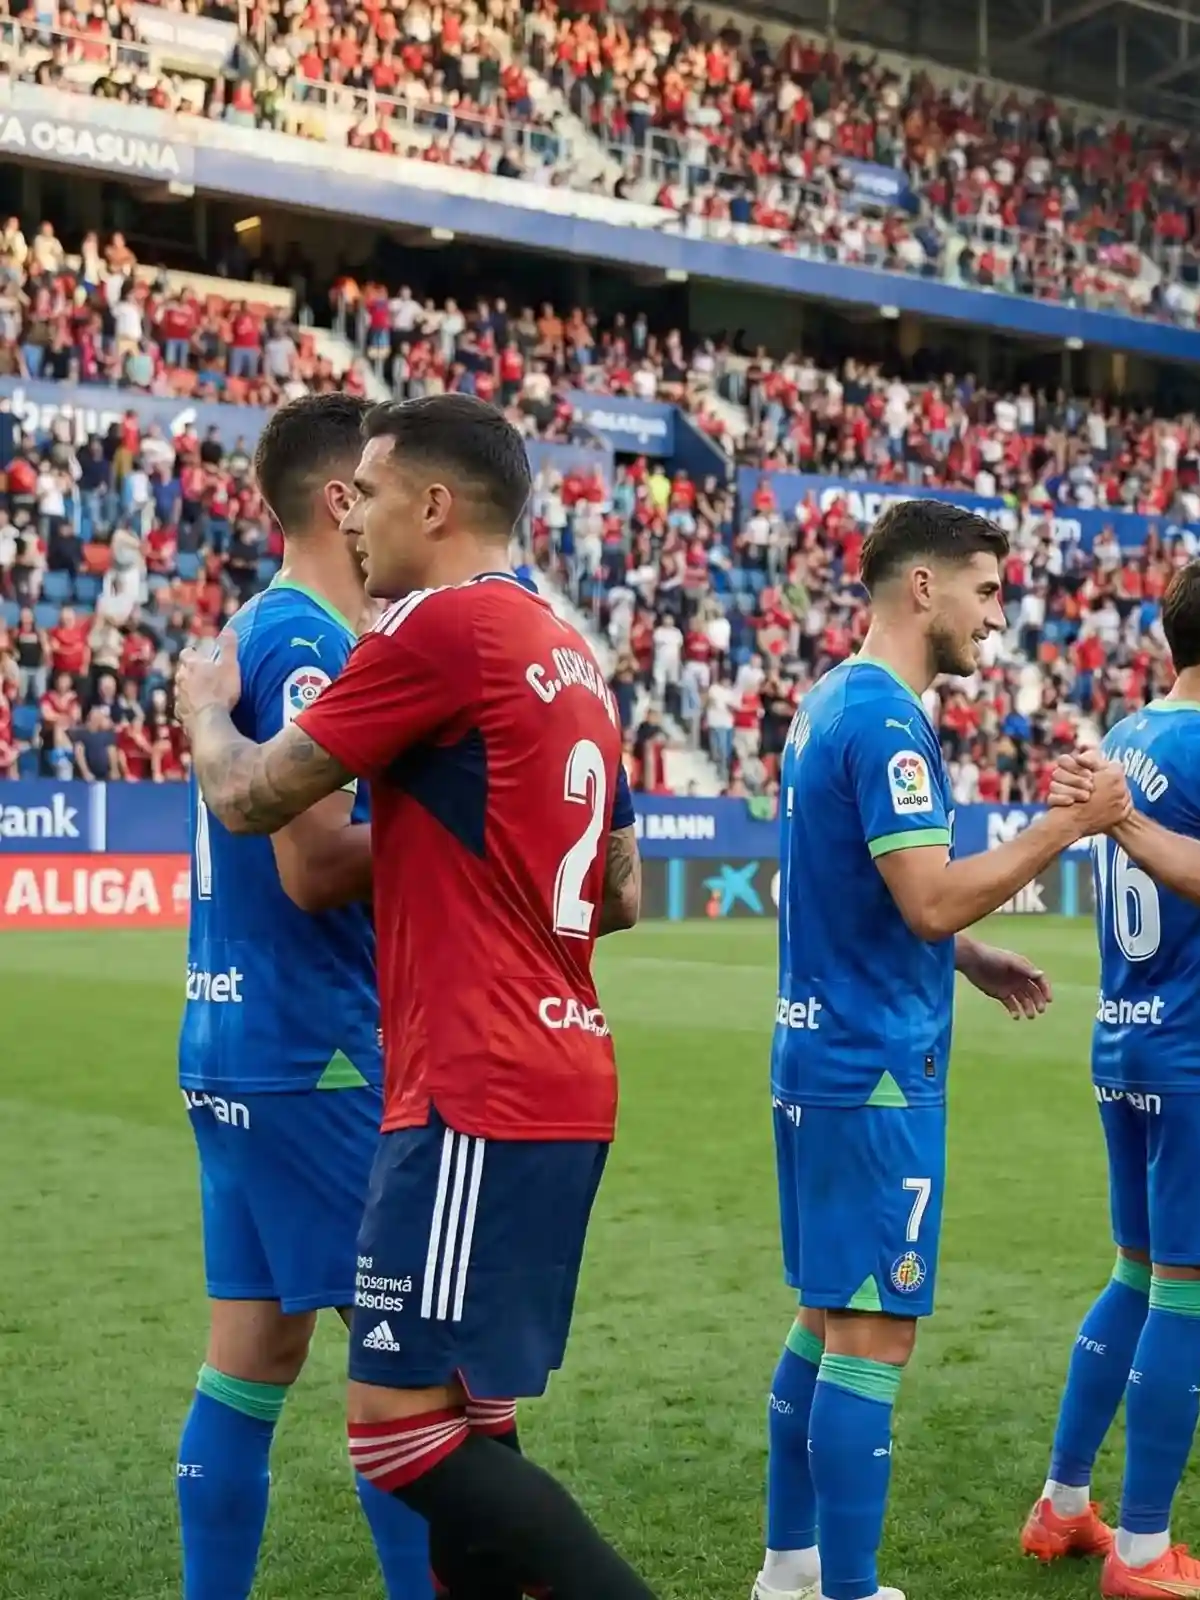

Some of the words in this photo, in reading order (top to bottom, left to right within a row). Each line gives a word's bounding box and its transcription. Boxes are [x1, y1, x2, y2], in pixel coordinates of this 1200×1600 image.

[31, 120, 180, 176] OSASUNA
[0, 792, 80, 838] ank
[552, 738, 606, 941] 2
[902, 1177, 931, 1242] 7
